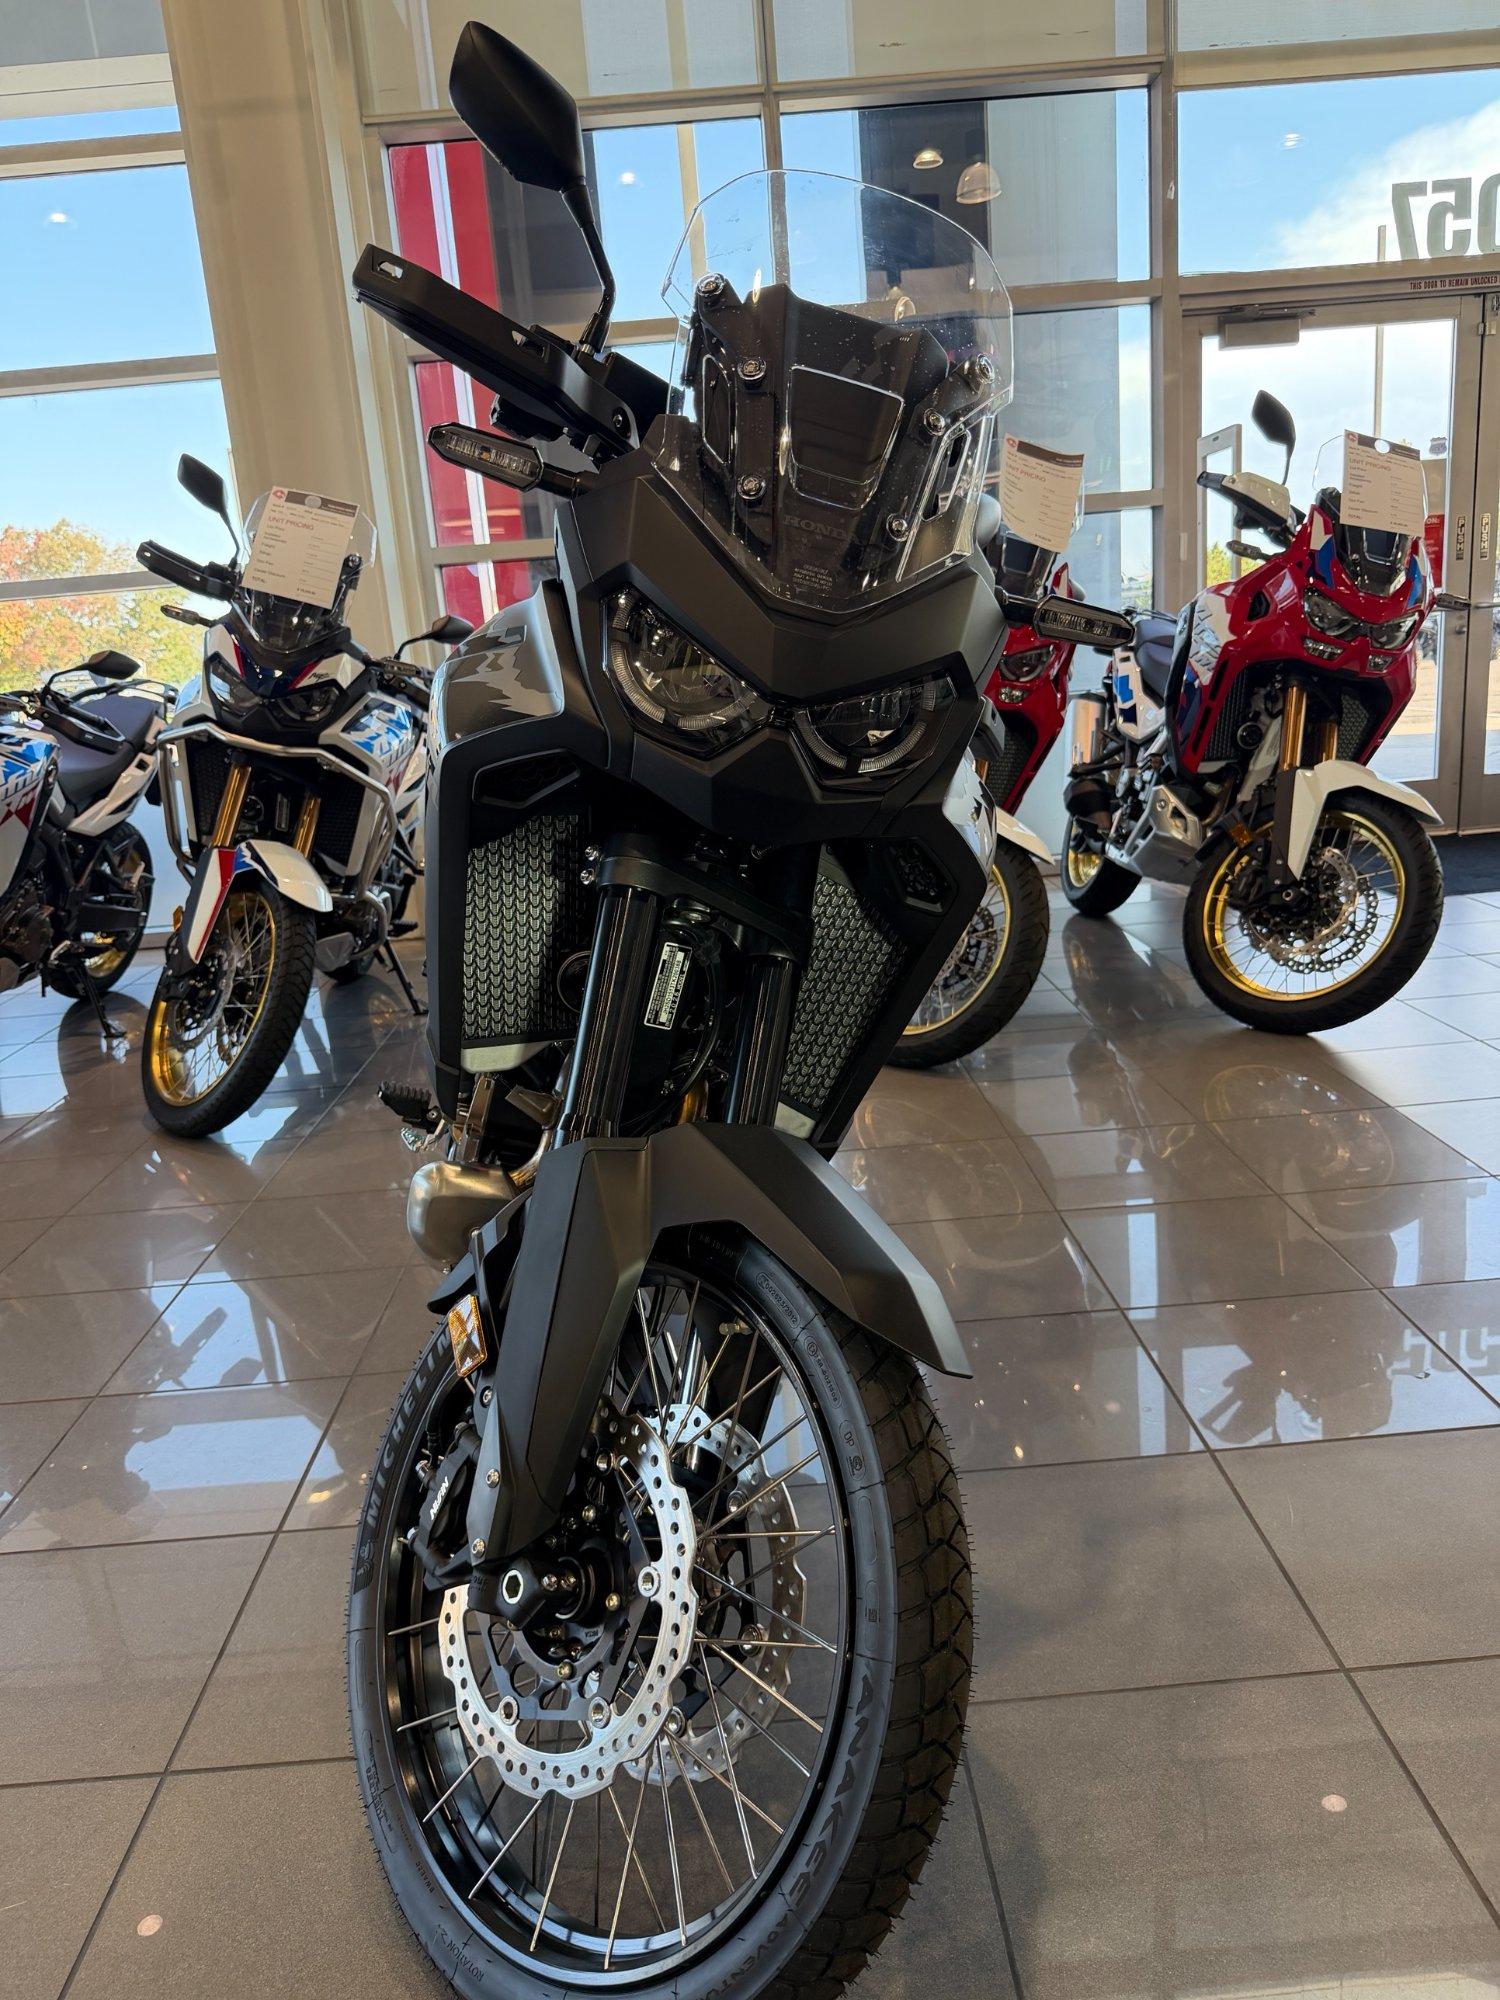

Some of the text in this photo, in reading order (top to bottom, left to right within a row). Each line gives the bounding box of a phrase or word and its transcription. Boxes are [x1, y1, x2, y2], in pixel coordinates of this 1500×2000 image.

[1440, 280, 1446, 288] TO
[1448, 278, 1468, 287] REMAIN
[1470, 276, 1497, 286] UNLOCKED
[784, 515, 856, 543] HOND
[1457, 519, 1465, 551] PUSH
[1481, 518, 1489, 549] PUSH
[366, 1328, 450, 1529] MICHELIN
[788, 1668, 875, 1907] ANAKEE
[447, 1937, 484, 1982] ROTATION
